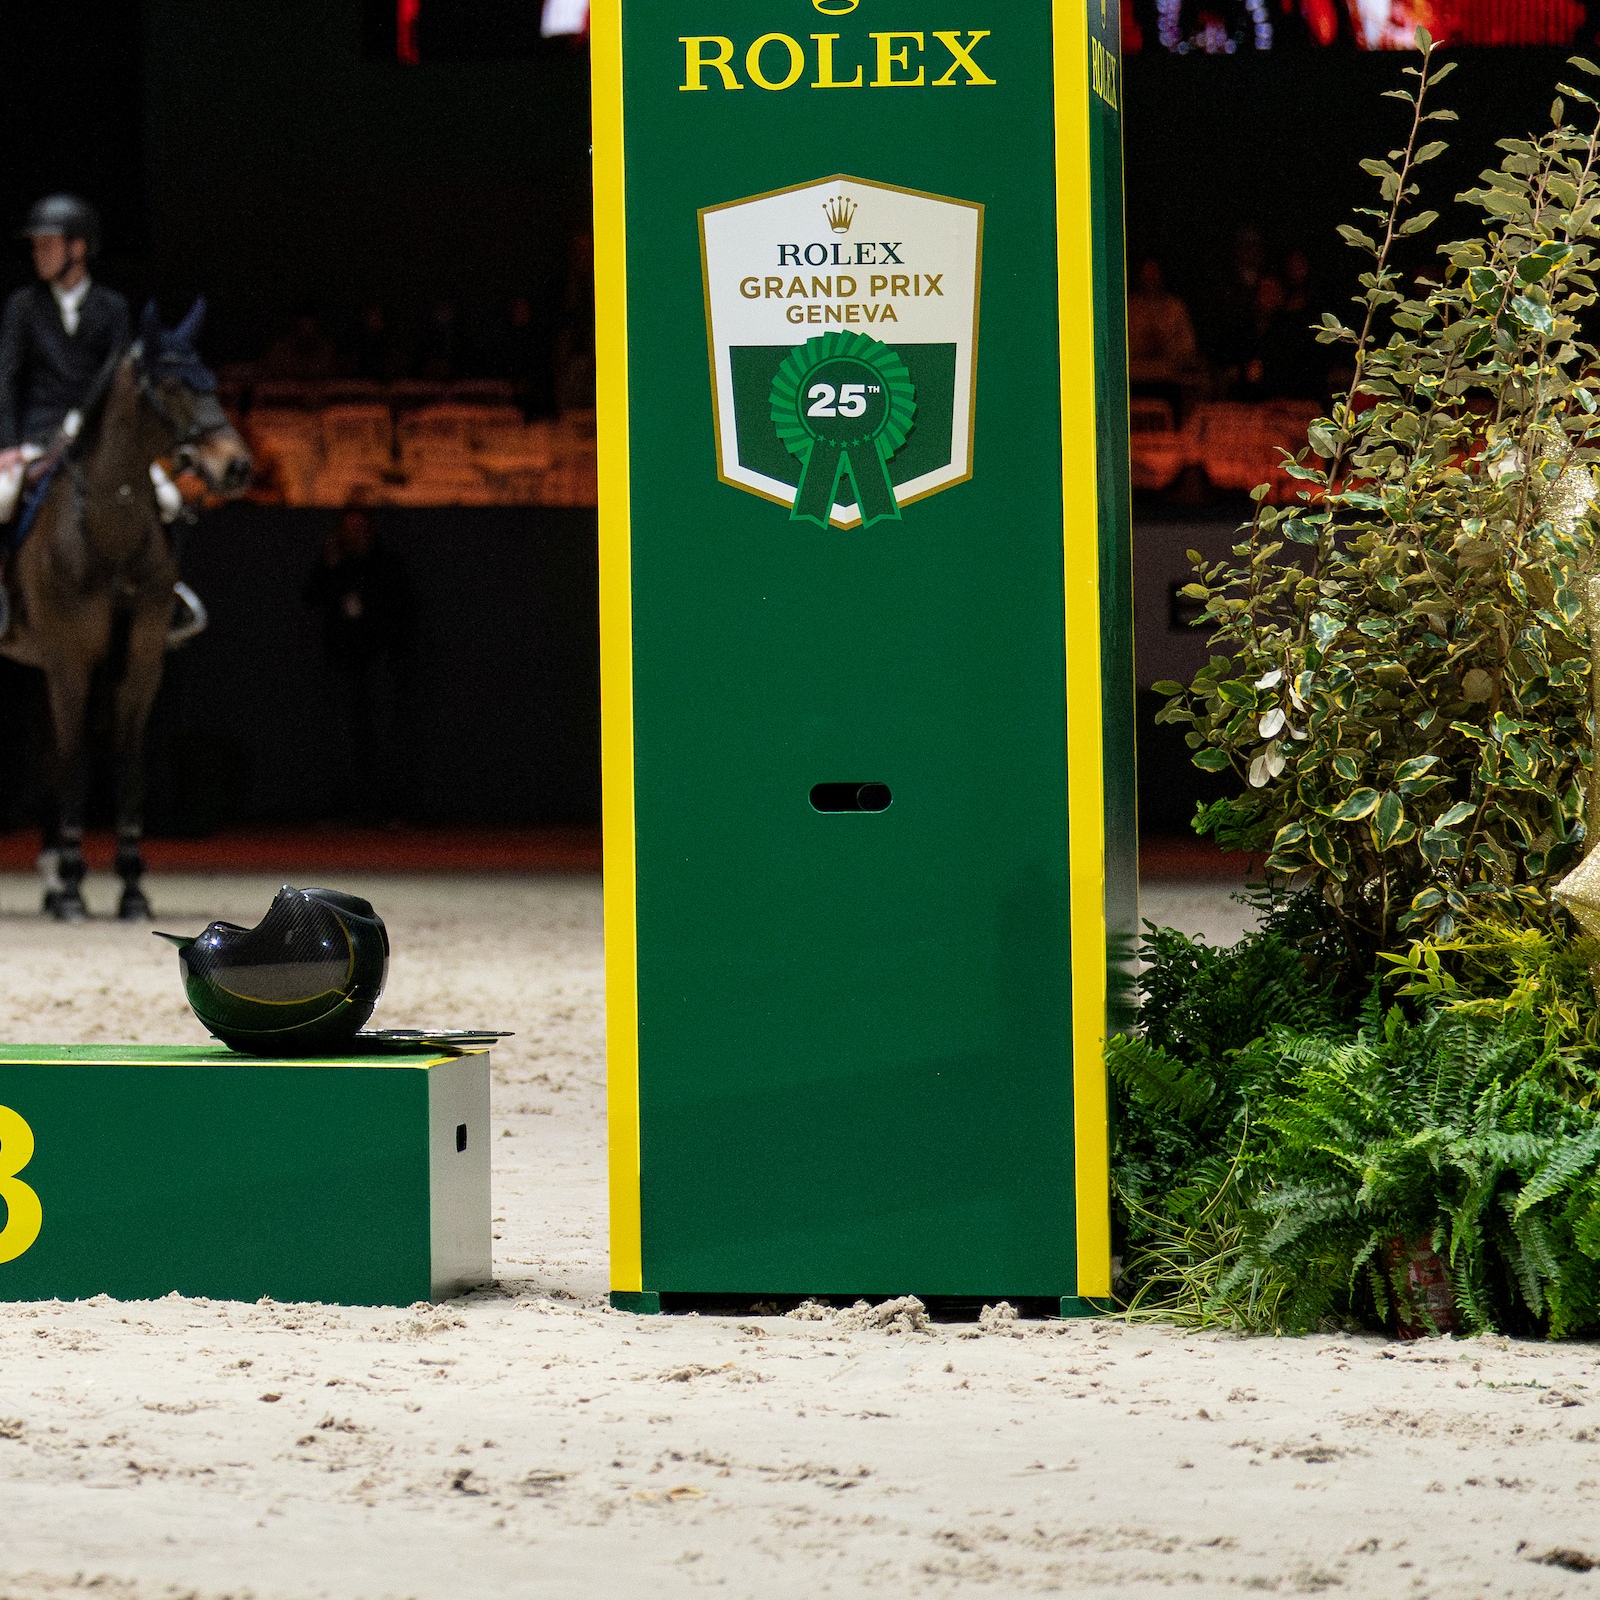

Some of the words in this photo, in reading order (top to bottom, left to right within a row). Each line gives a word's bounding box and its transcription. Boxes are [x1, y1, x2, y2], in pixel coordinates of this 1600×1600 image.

[678, 30, 996, 91] ROLEX
[1091, 36, 1117, 111] ROLEX
[777, 242, 905, 266] ROLEX
[739, 275, 857, 299] GRAND
[870, 274, 944, 297] PRIX
[786, 303, 899, 324] GENEVA
